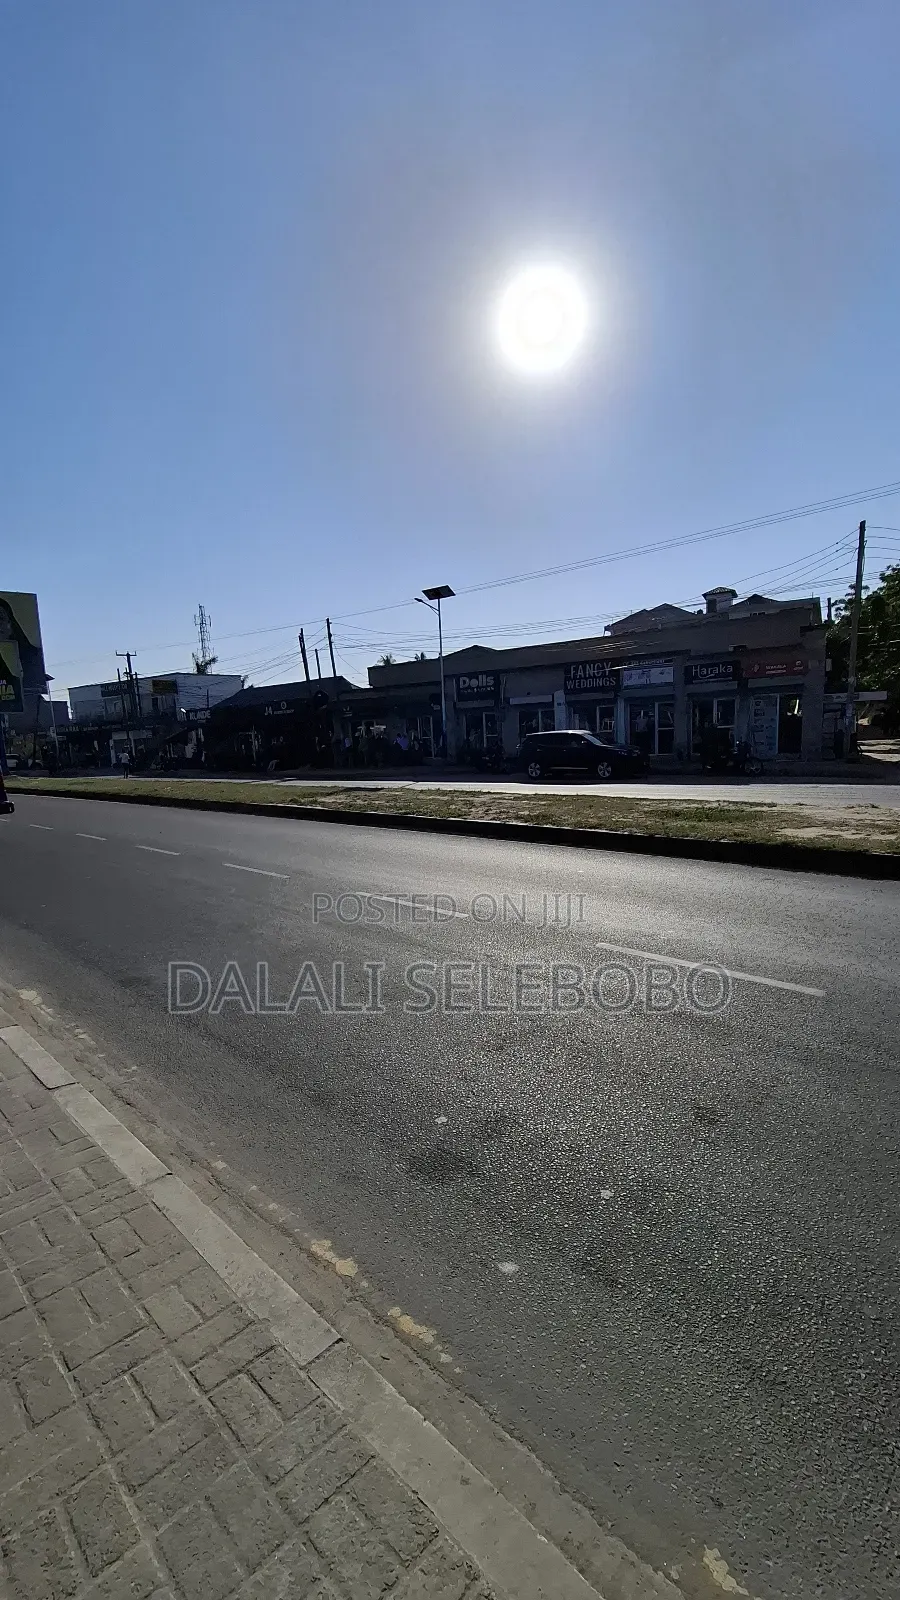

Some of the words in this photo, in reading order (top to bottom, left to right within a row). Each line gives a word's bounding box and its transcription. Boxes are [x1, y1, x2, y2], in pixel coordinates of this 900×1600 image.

[571, 662, 612, 679] FANCY
[692, 664, 733, 678] Haraka
[460, 674, 494, 688] Dolls
[566, 677, 616, 689] WEDDINGS
